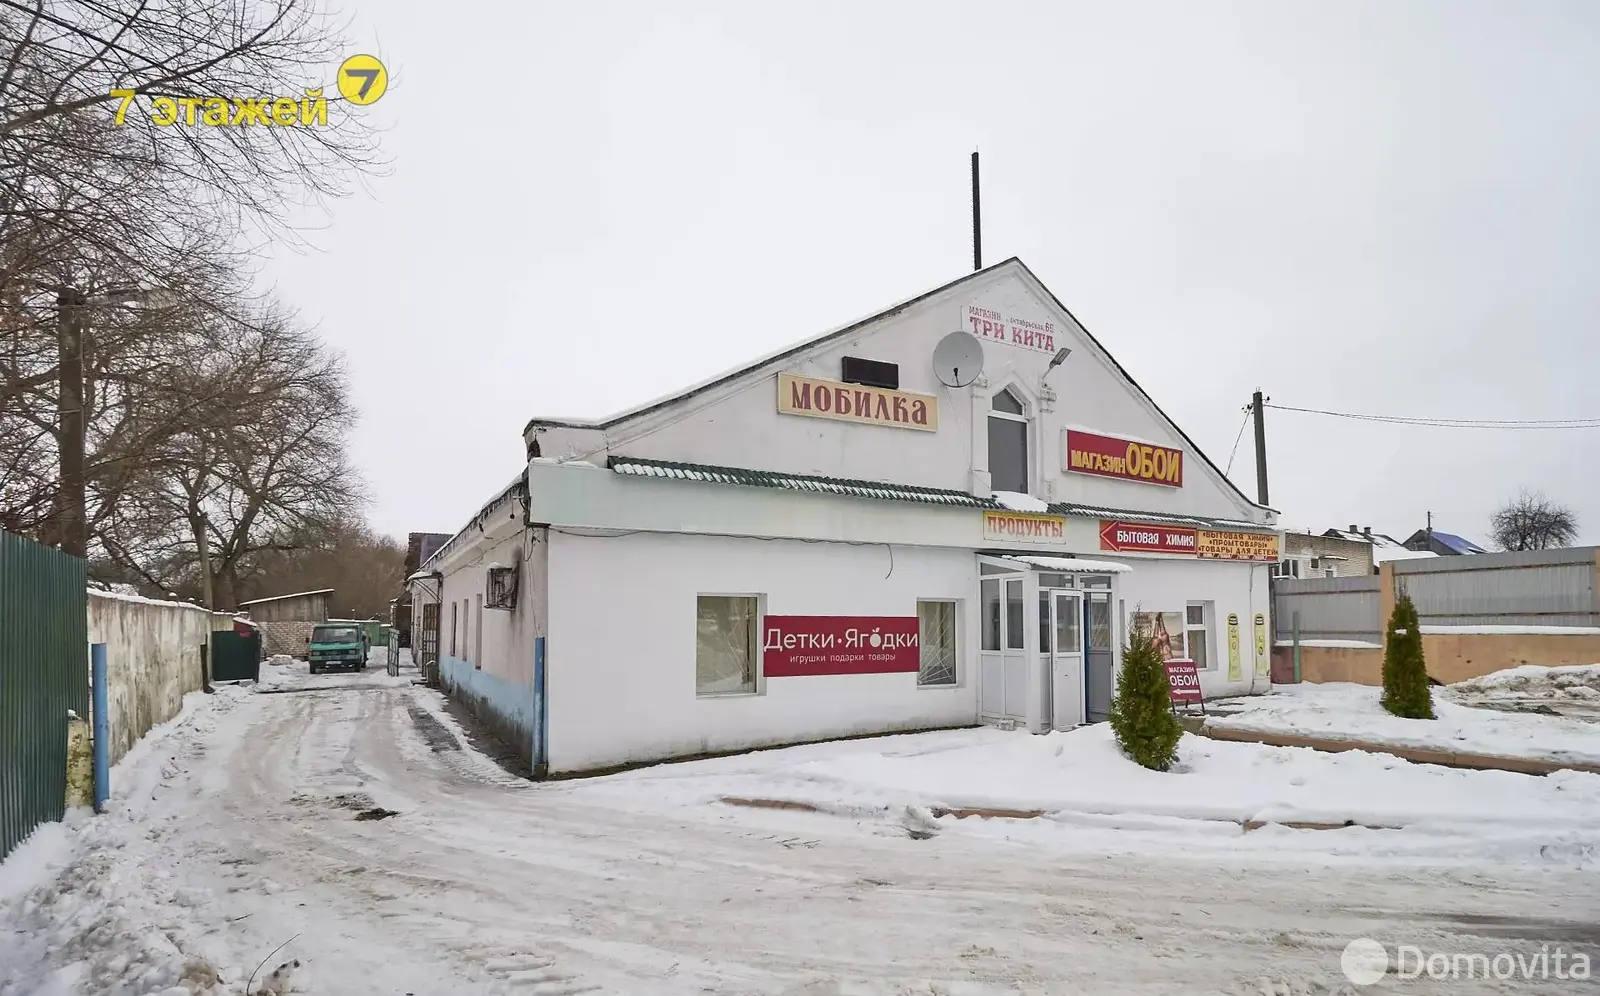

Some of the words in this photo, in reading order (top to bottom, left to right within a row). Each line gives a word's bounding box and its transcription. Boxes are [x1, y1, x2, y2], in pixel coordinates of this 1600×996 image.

[969, 306, 1001, 321] МАГАЗИН
[970, 316, 1005, 340] ТРИ
[1012, 327, 1055, 352] КИТА
[1071, 449, 1126, 474] МАГАЗИН
[1125, 442, 1180, 483] ОБОИ
[987, 516, 1063, 537] ПРОДУКТЫ
[1165, 533, 1194, 547] ХИМИЯ
[763, 628, 834, 652] Детки
[845, 627, 918, 650] Ягодки
[790, 654, 826, 665] игрушки
[830, 653, 864, 663] подарки
[868, 652, 896, 662] товары
[1170, 675, 1198, 686] ОБОИ
